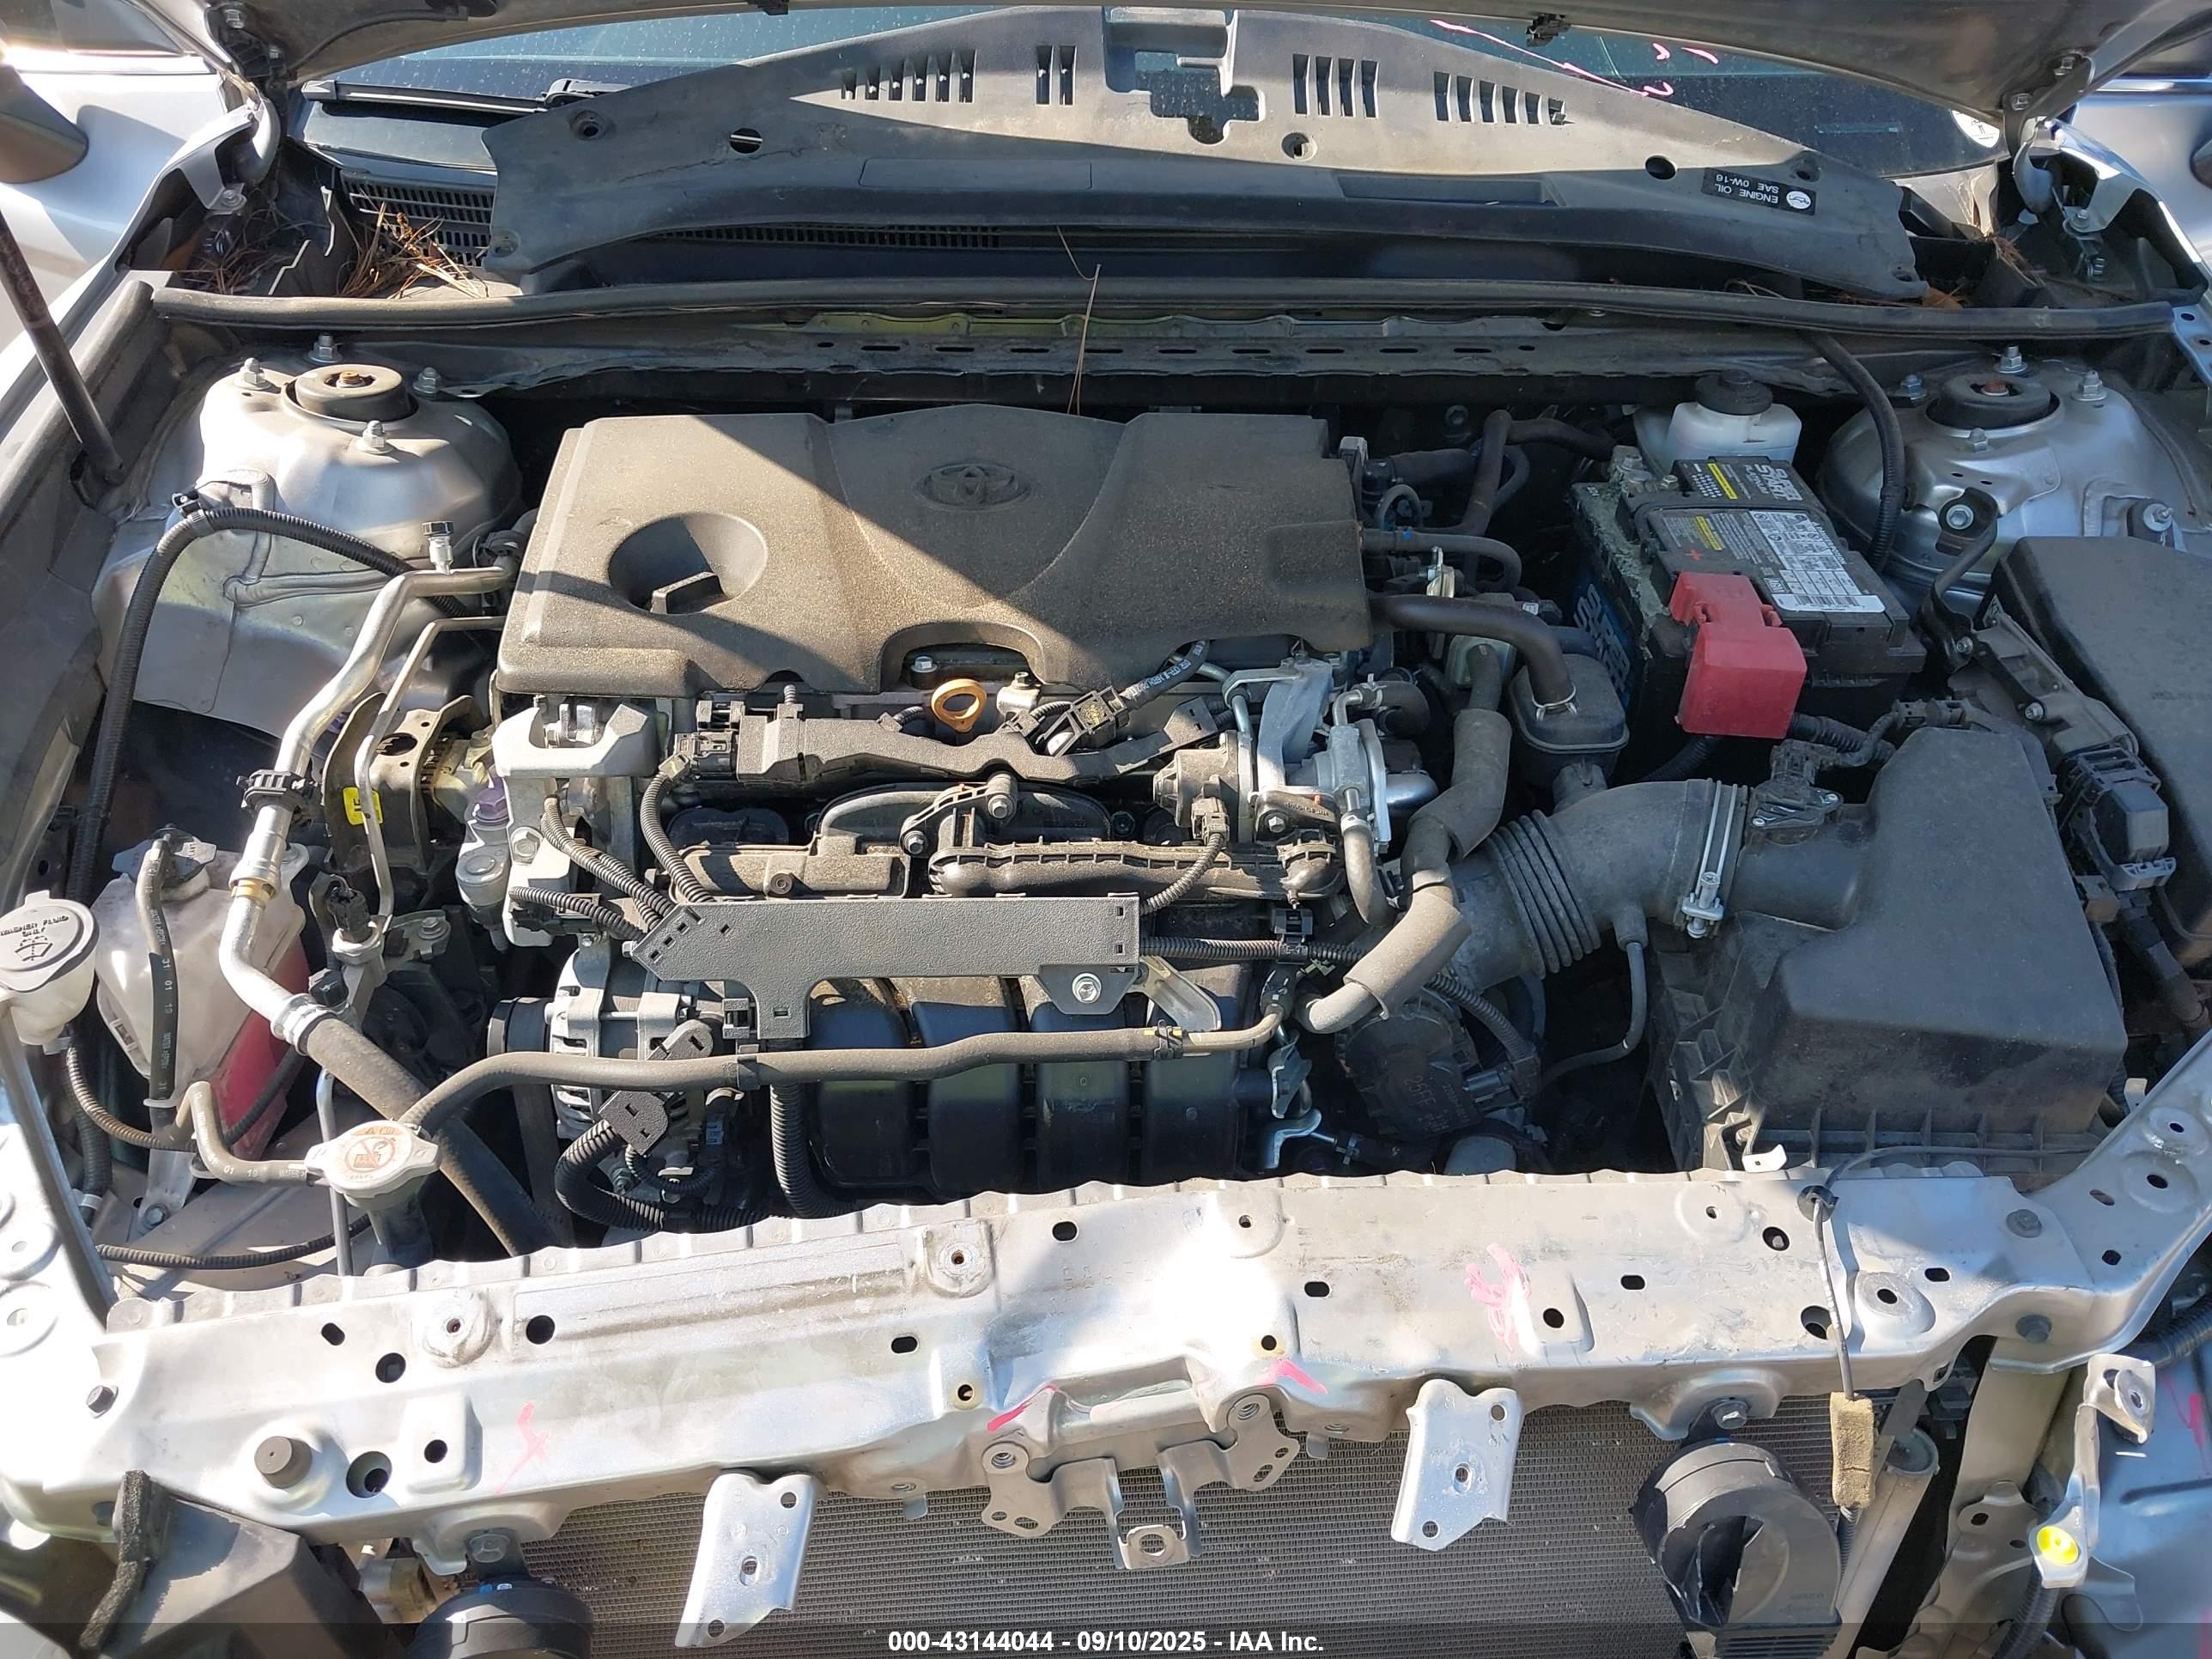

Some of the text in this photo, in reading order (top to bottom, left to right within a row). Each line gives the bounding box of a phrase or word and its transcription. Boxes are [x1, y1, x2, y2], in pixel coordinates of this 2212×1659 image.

[1716, 173, 1780, 194] SAE 0W-16
[1715, 184, 1778, 204] ENGINE OIL
[1744, 465, 1770, 495] PLATINUM
[1754, 464, 1786, 500] START
[1773, 468, 1803, 501] SUPER
[162, 957, 172, 969] 31
[164, 980, 173, 991] 01
[223, 1164, 235, 1175] 01
